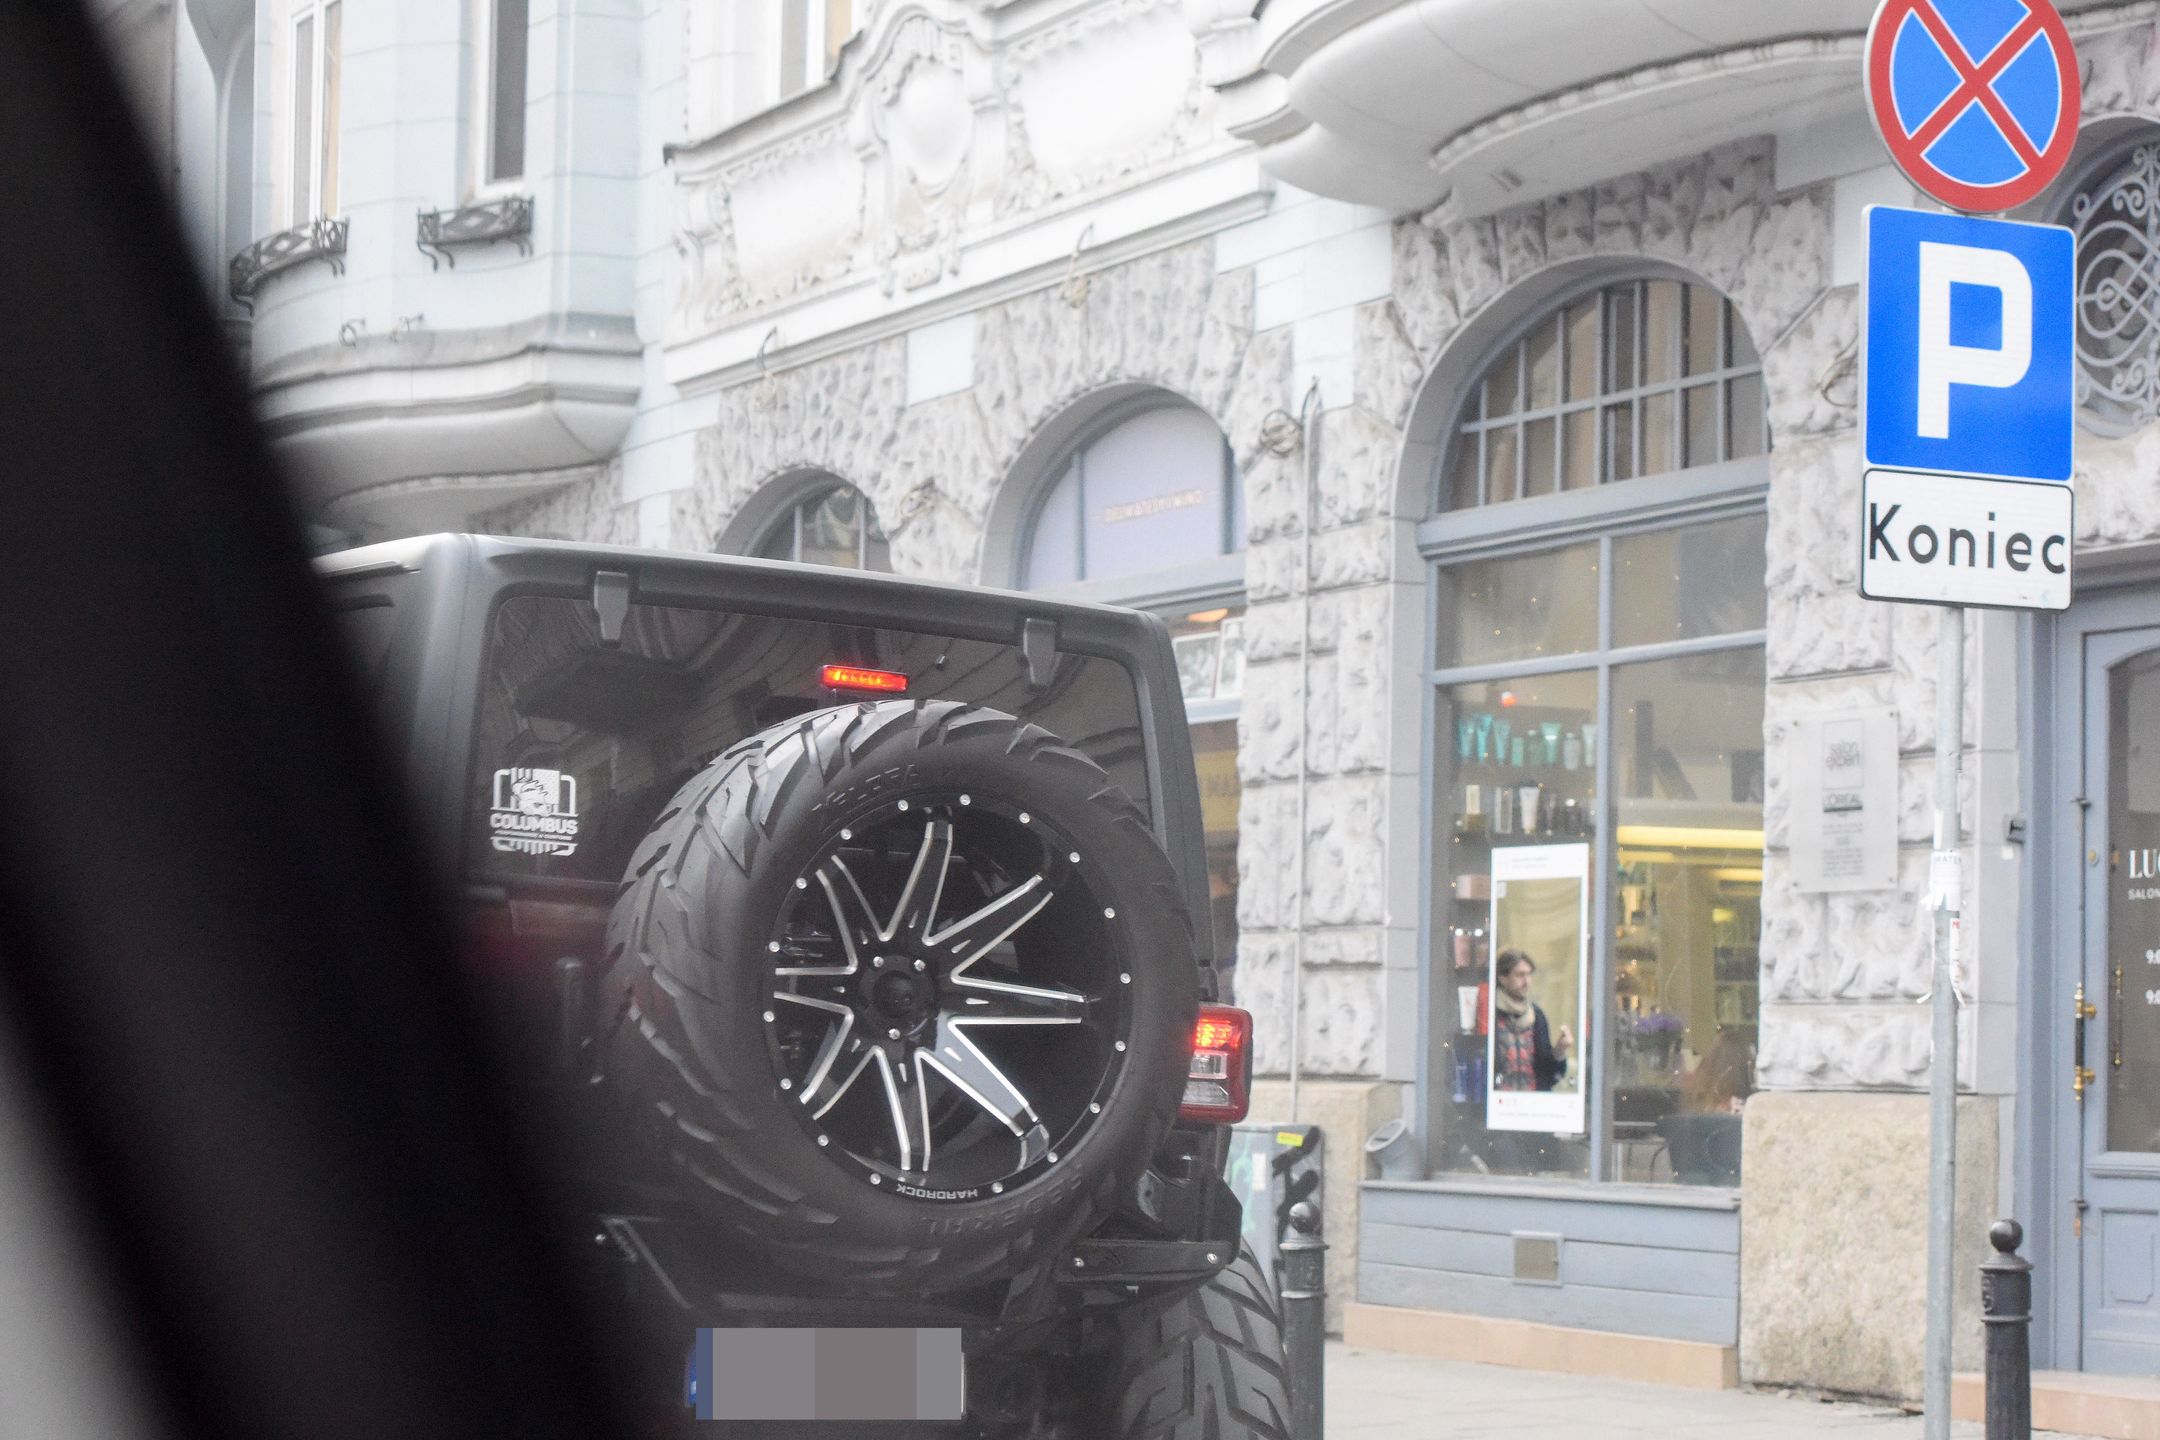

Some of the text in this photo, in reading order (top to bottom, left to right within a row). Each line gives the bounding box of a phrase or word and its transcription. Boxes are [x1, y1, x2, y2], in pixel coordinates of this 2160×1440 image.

[1917, 241, 2033, 439] P
[1869, 502, 2066, 575] Koniec
[490, 813, 578, 835] COLUMBUS
[2129, 848, 2160, 879] LU
[896, 1183, 978, 1199] HARDROCK
